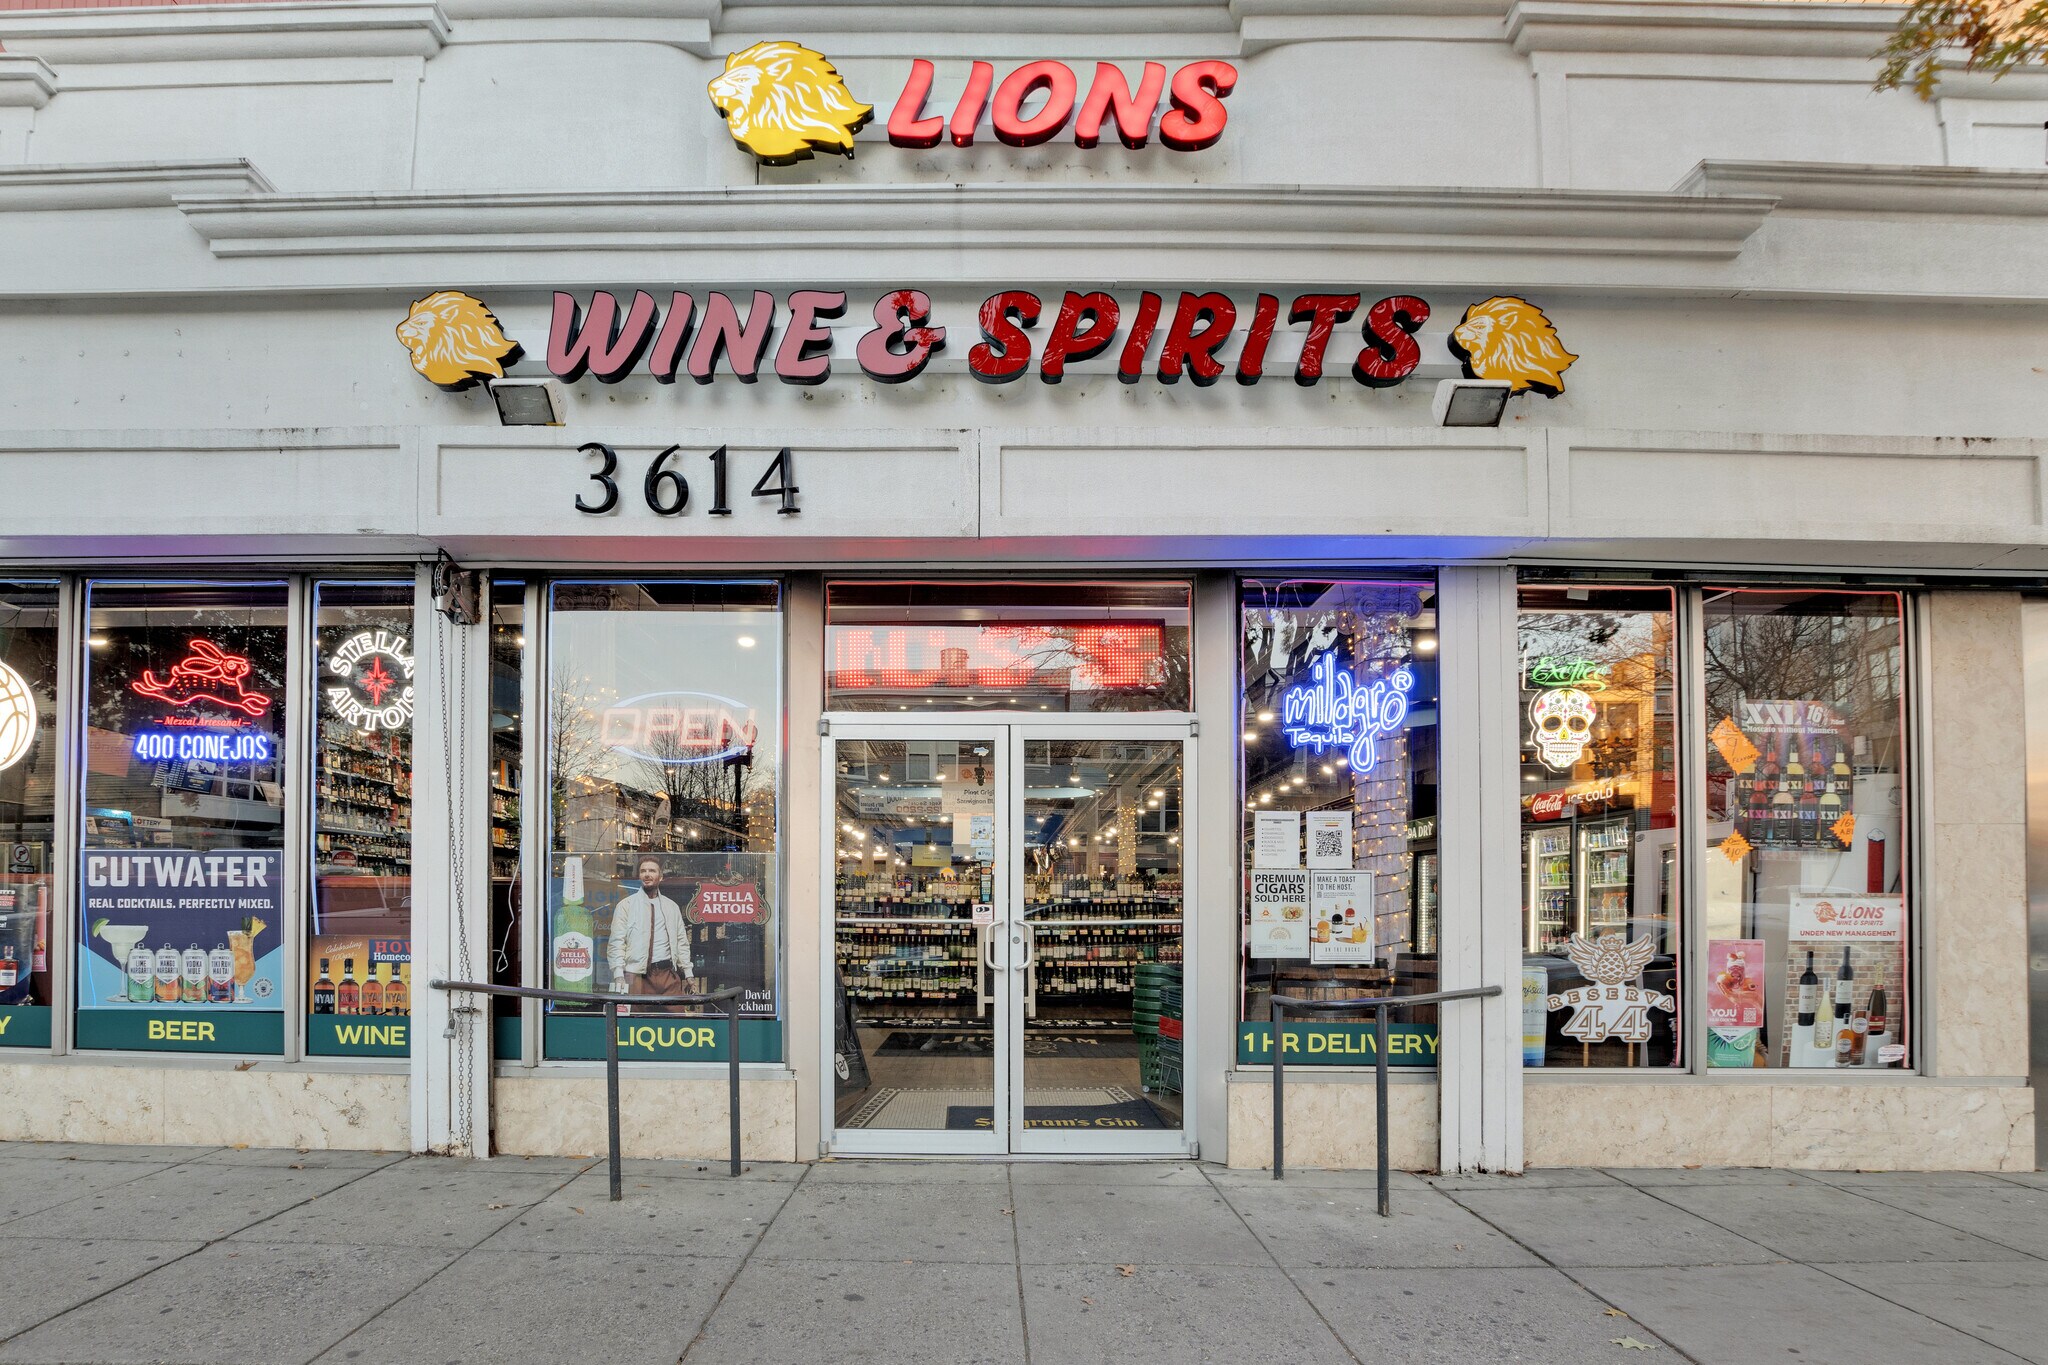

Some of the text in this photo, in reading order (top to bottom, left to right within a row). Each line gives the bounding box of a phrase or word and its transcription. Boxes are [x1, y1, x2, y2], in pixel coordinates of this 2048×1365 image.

[888, 58, 1239, 152] LIONS
[546, 289, 1431, 389] WINE & SPIRITS
[575, 441, 801, 516] 3614
[164, 716, 242, 727] Mezcal Artesanal
[1746, 704, 1802, 725] XXL
[601, 707, 756, 748] OPEN
[1747, 725, 1776, 733] Moscato
[136, 734, 268, 760] 400 CONEJOS
[1285, 728, 1354, 753] Tequila
[1585, 787, 1614, 803] COLD
[1773, 810, 1791, 819] XXL
[1798, 810, 1818, 820] XXL
[1820, 811, 1839, 820] XXL
[1254, 874, 1306, 883] PREMIUM
[1256, 883, 1305, 894] CIGARS
[89, 899, 274, 909] REAL COCKTAILS. PERFECTLY MIXED.
[702, 891, 754, 903] STELLA
[1254, 894, 1306, 903] SOLD HERE
[702, 903, 755, 914] ARTOIS
[1839, 905, 1885, 919] LIONS
[745, 989, 771, 1000] David
[1548, 987, 1674, 1011] RESERVA
[1710, 1008, 1737, 1018] YOJU
[148, 1020, 216, 1041] BEER
[1564, 1006, 1651, 1041] 44
[335, 1024, 406, 1046] WINE
[616, 1026, 716, 1052] LIQUOR
[1243, 1032, 1254, 1053] 1
[974, 1117, 1091, 1129] Sgram's
